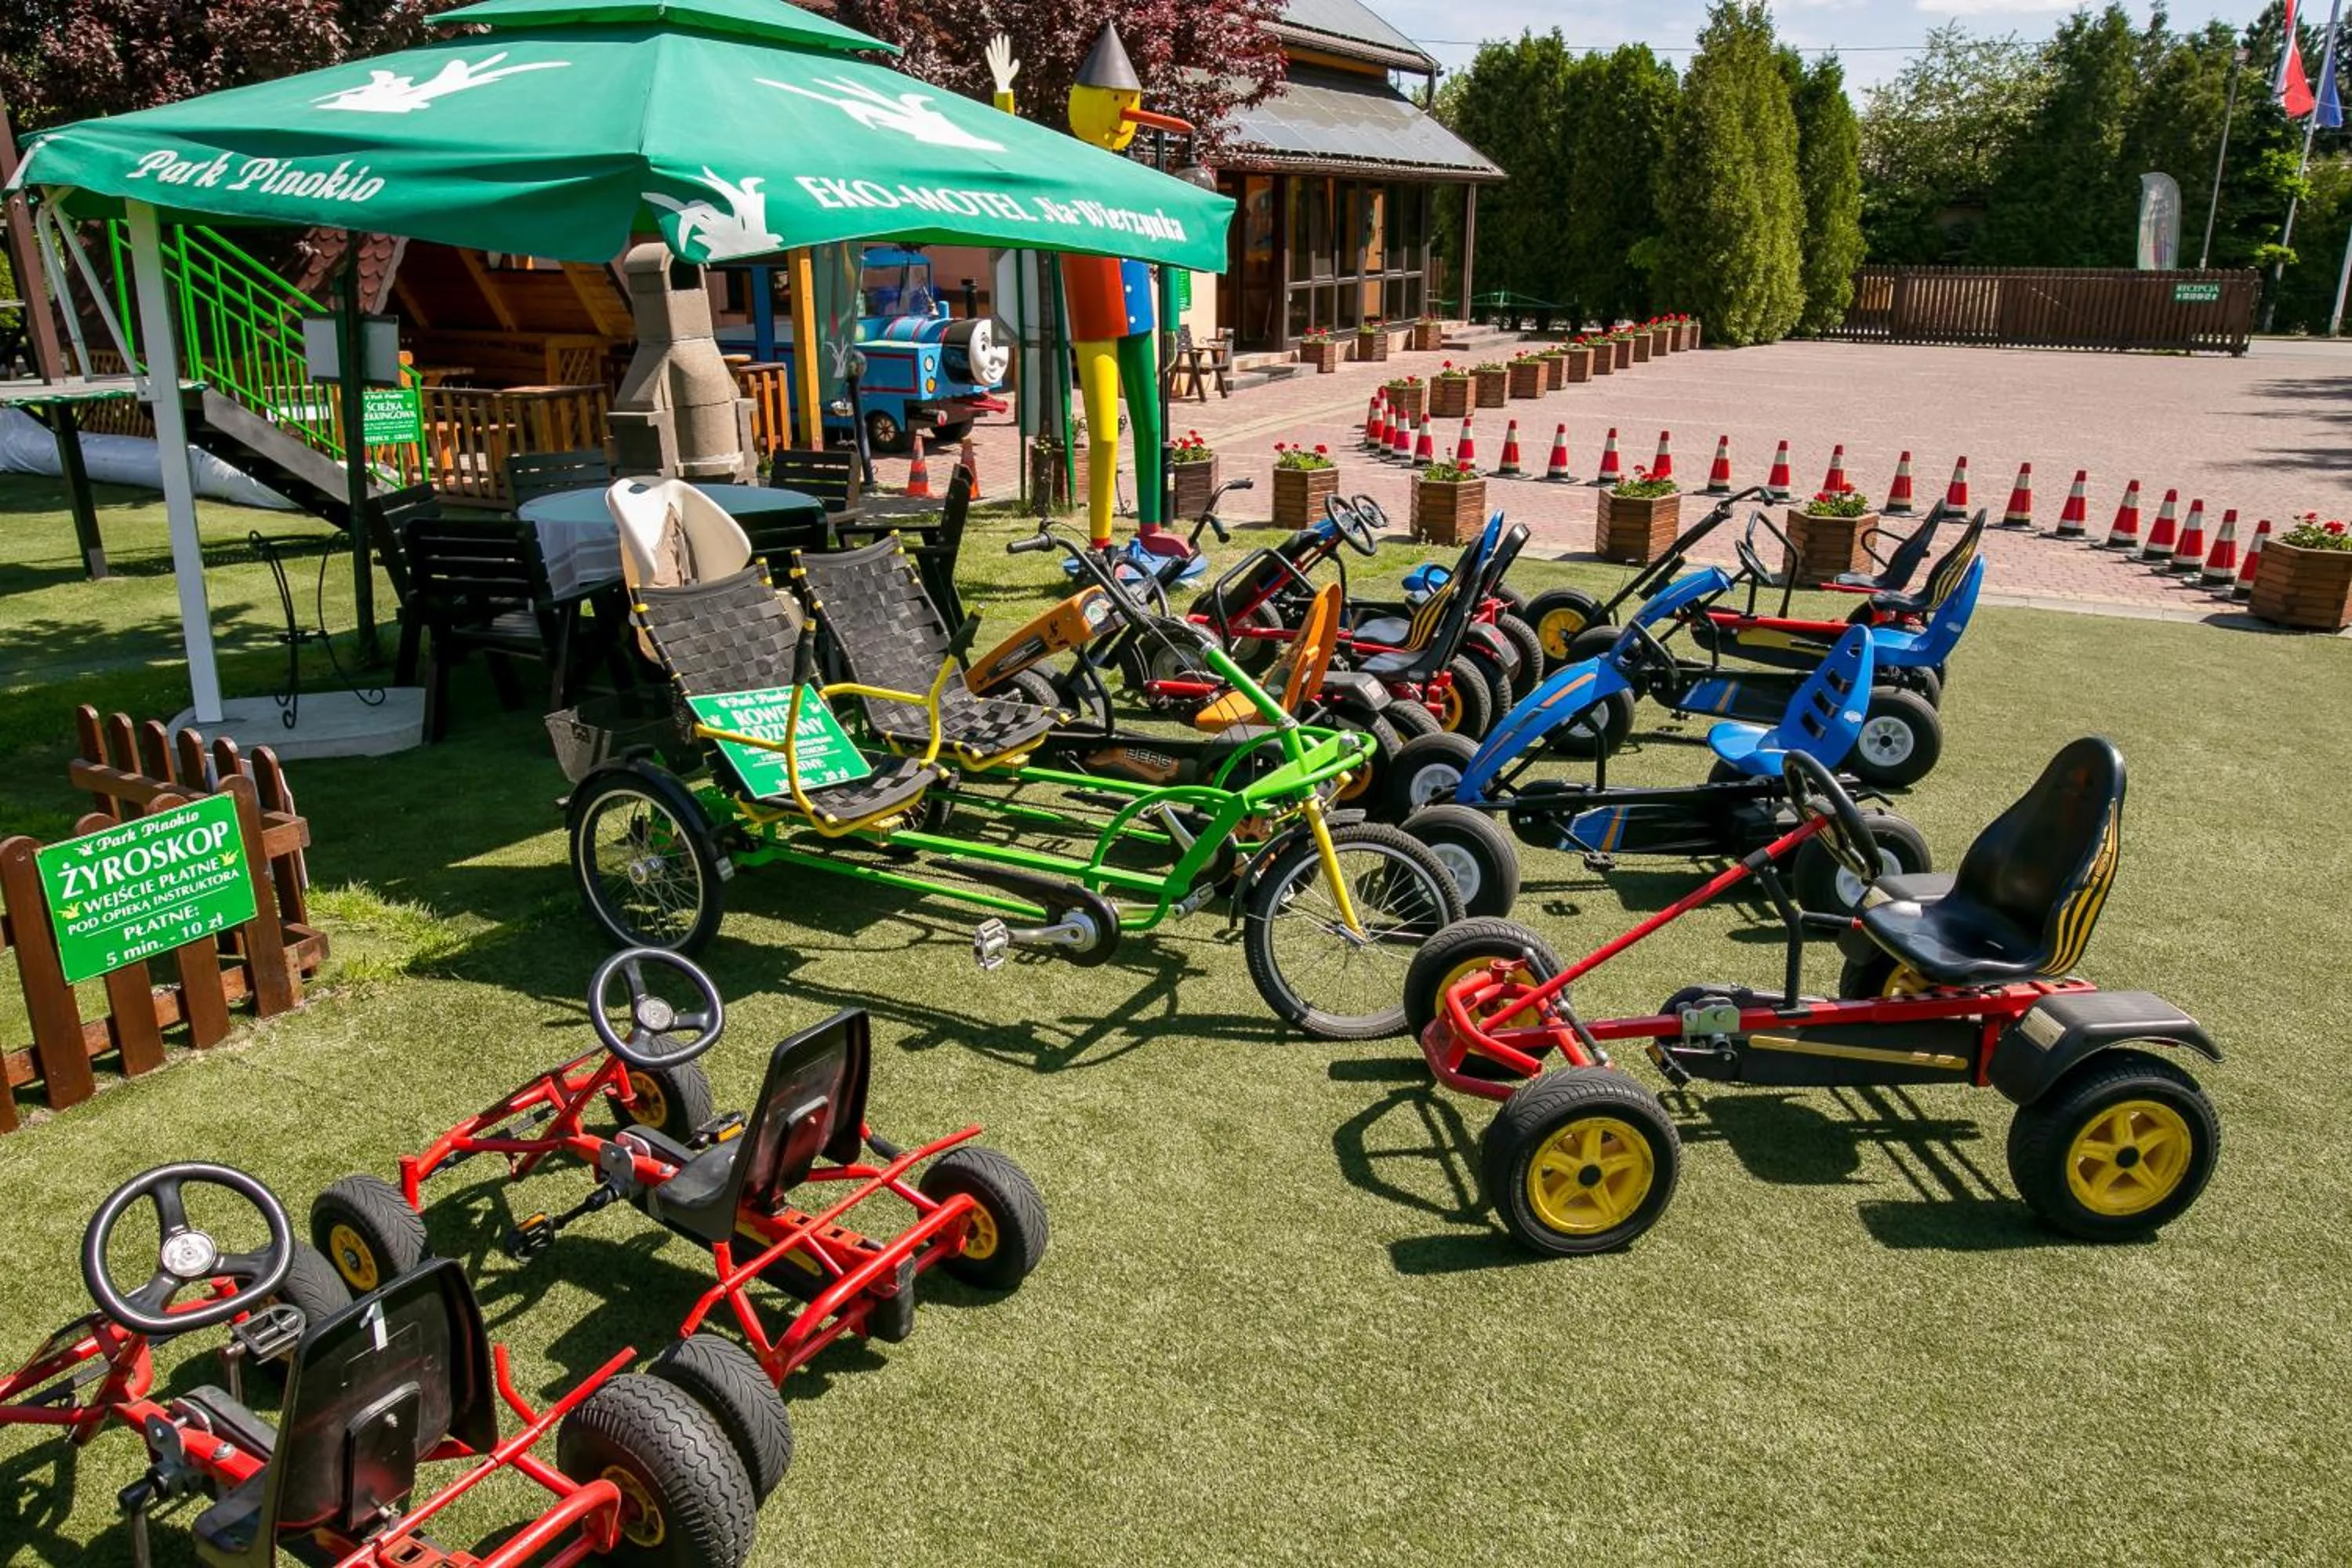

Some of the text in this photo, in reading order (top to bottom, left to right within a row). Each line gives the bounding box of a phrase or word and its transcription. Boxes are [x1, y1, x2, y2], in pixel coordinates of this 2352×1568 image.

[125, 150, 385, 201] Park Pinokio
[795, 176, 1038, 222] EKO-MOTEL
[731, 703, 803, 726] ROWE
[96, 811, 200, 852] Park Pinokio
[57, 821, 229, 899] ŻYROSKOP
[82, 858, 220, 913] WEJŚCIE PŁATNE
[67, 869, 240, 935] POD OPIEKĄ INSTRUKTORA
[123, 906, 200, 941] PŁATNE:
[106, 951, 118, 967] 5
[123, 937, 164, 961] min.
[181, 921, 202, 939] 10
[209, 912, 223, 929] zł
[359, 1298, 388, 1352] 1
